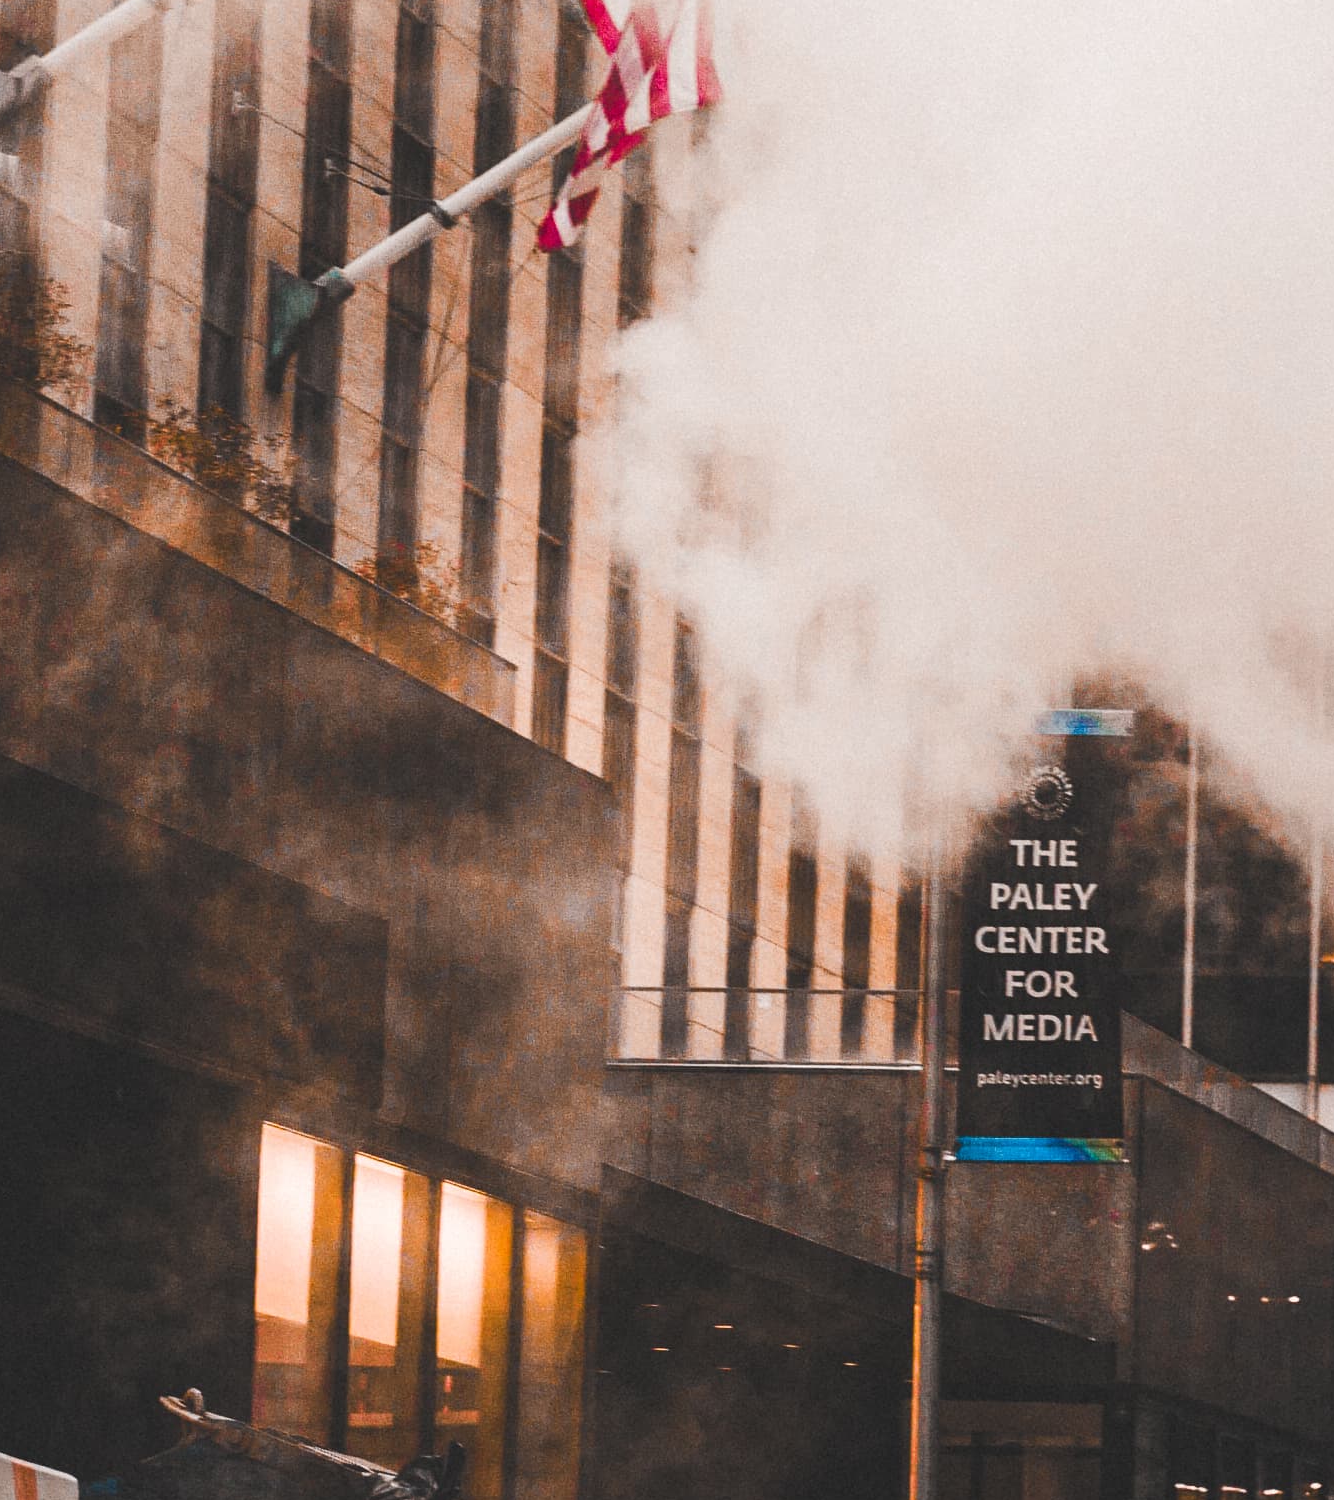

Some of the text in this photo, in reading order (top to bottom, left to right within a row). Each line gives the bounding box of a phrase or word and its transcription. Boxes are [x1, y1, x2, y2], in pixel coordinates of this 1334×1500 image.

[1009, 839, 1079, 868] THE
[990, 882, 1098, 911] PALEY
[974, 926, 1110, 955] CENTER
[1004, 969, 1079, 999] FOR
[982, 1013, 1099, 1042] MEDIA
[977, 1069, 1104, 1089] paleycenter.org
